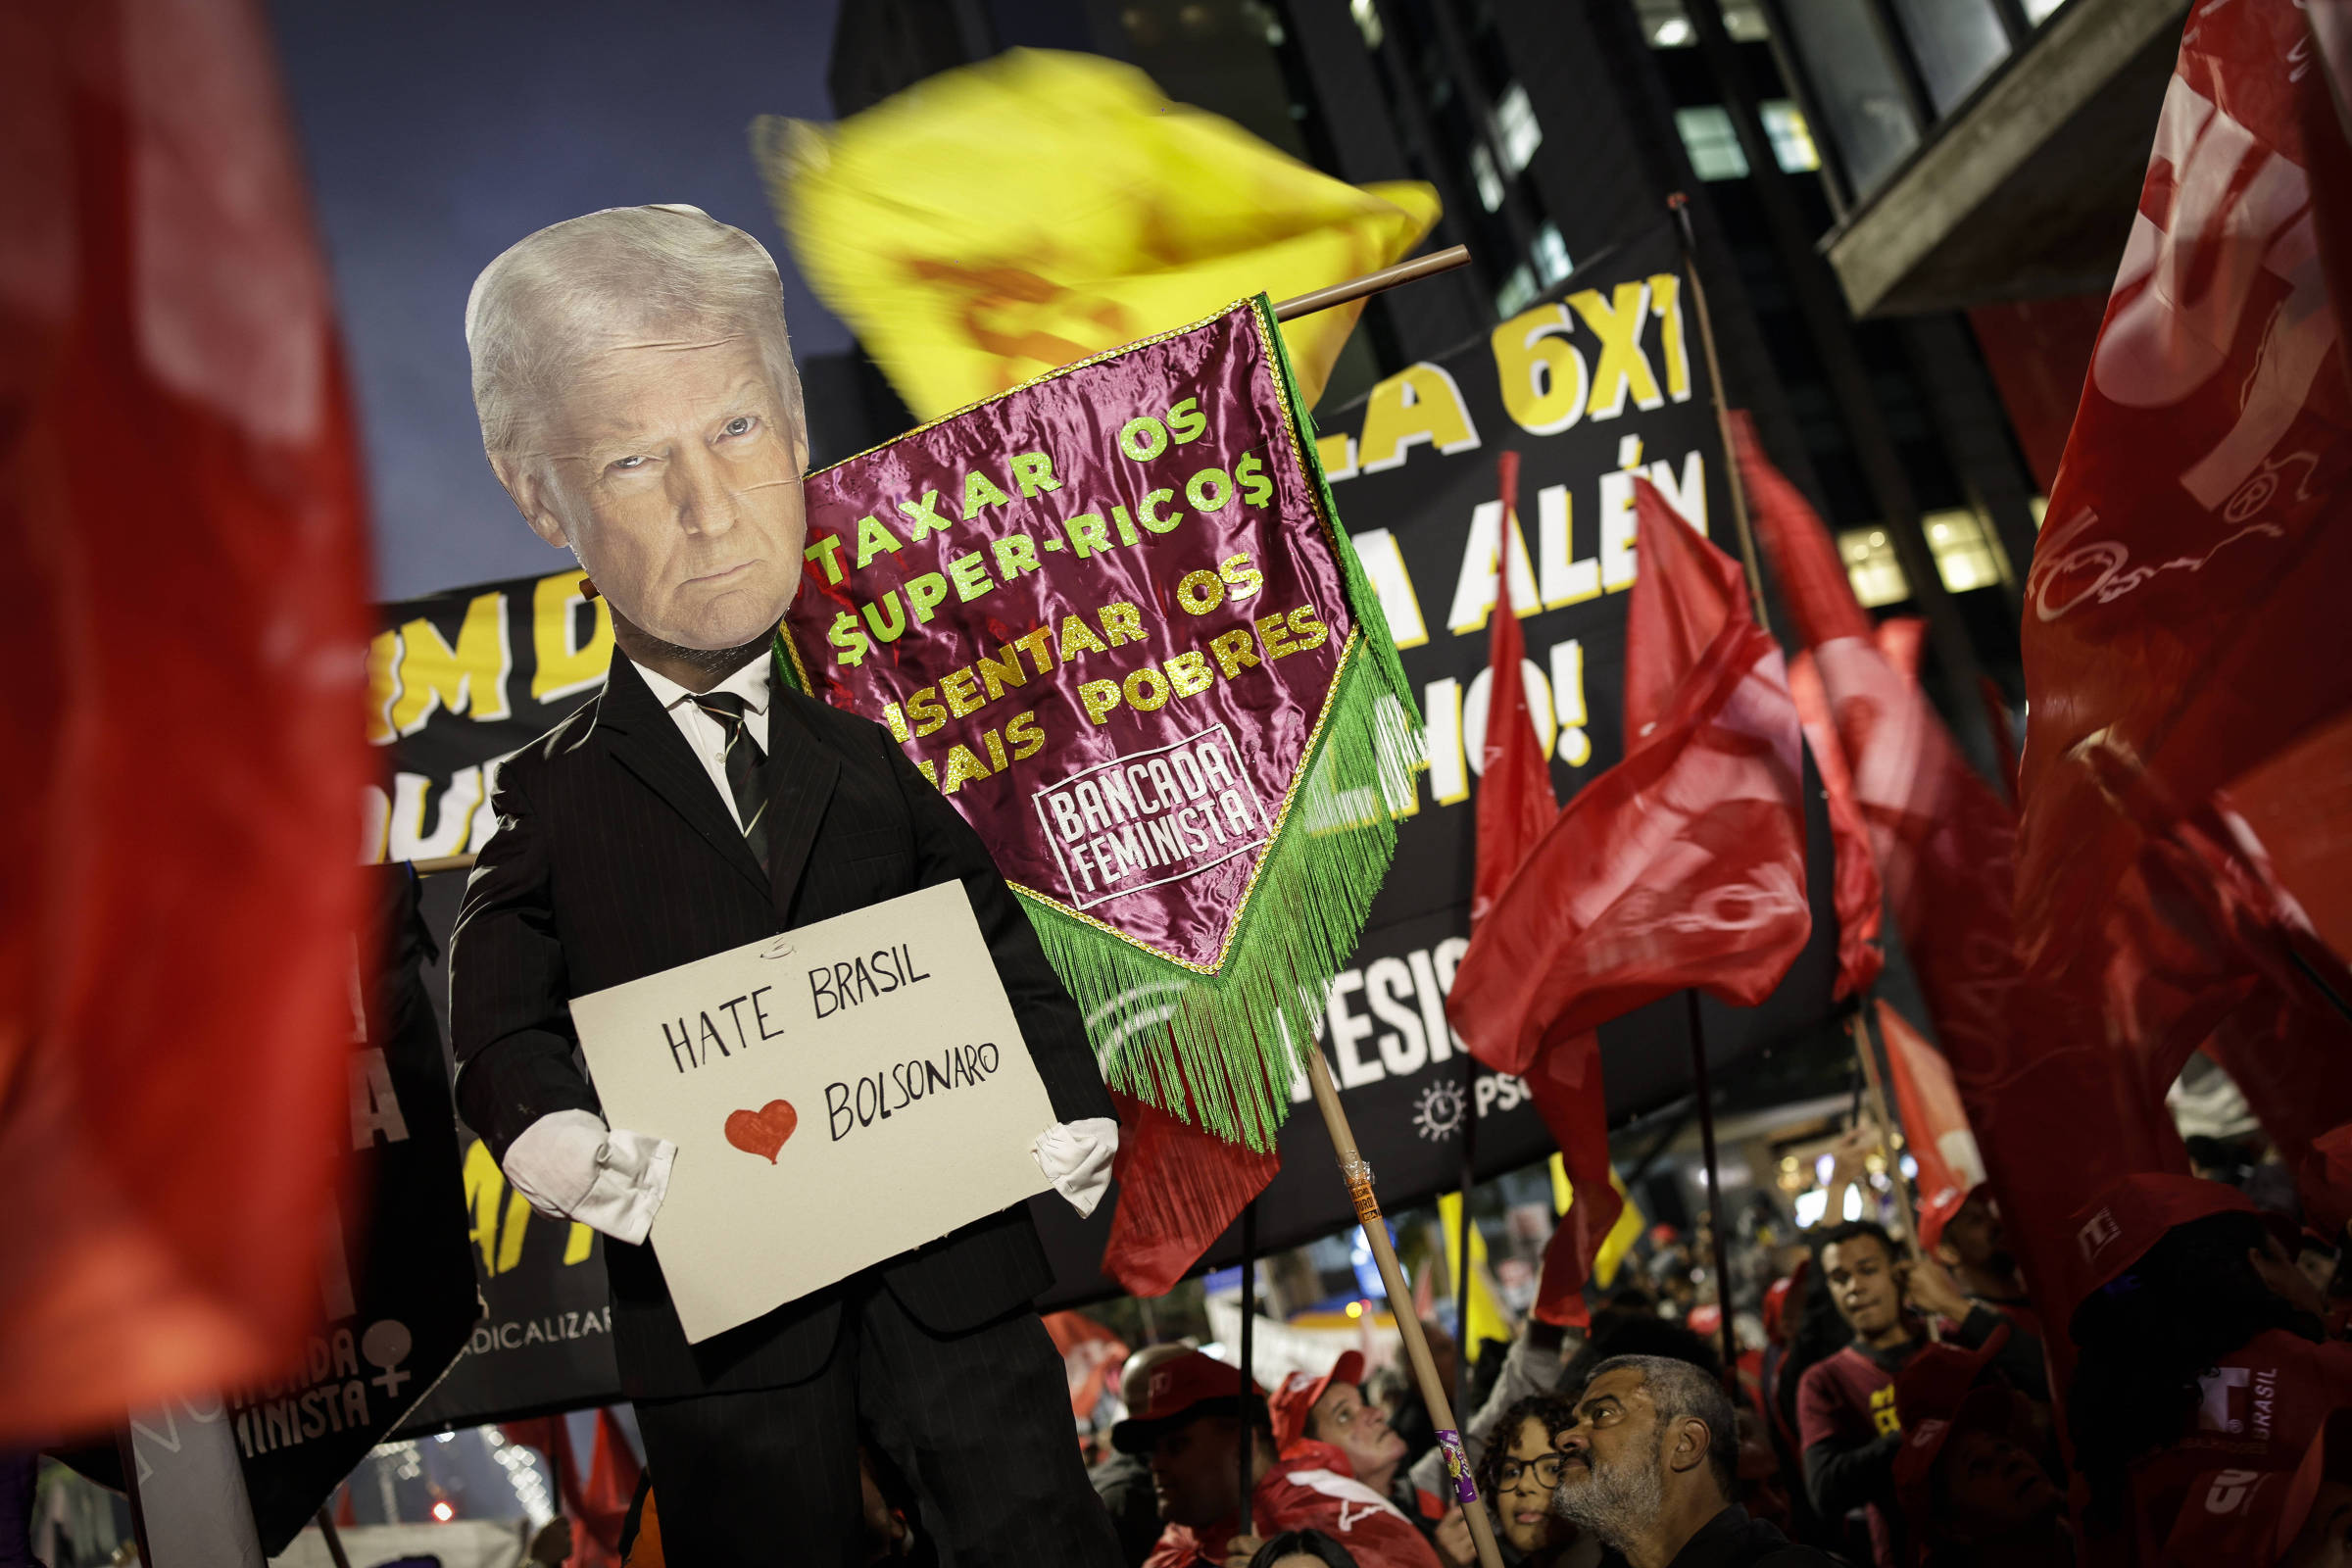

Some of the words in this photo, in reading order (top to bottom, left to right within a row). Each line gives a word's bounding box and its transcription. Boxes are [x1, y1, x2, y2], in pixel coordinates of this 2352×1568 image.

[1491, 273, 1691, 436] 6X1
[804, 451, 1062, 586] TAXAR
[1119, 397, 1208, 464] OS
[827, 449, 1274, 668] $UPER-RICO$
[883, 601, 1150, 744] ISENTAR
[1177, 552, 1264, 618] OS
[916, 710, 1047, 797] AIS
[1077, 603, 1330, 727] POBRES
[1047, 741, 1237, 844] BANCADA
[1072, 788, 1257, 893] FEMINISTA
[661, 985, 785, 1074] HATE
[808, 943, 931, 1020] BRASIL
[823, 1042, 1001, 1143] BOLSONARO
